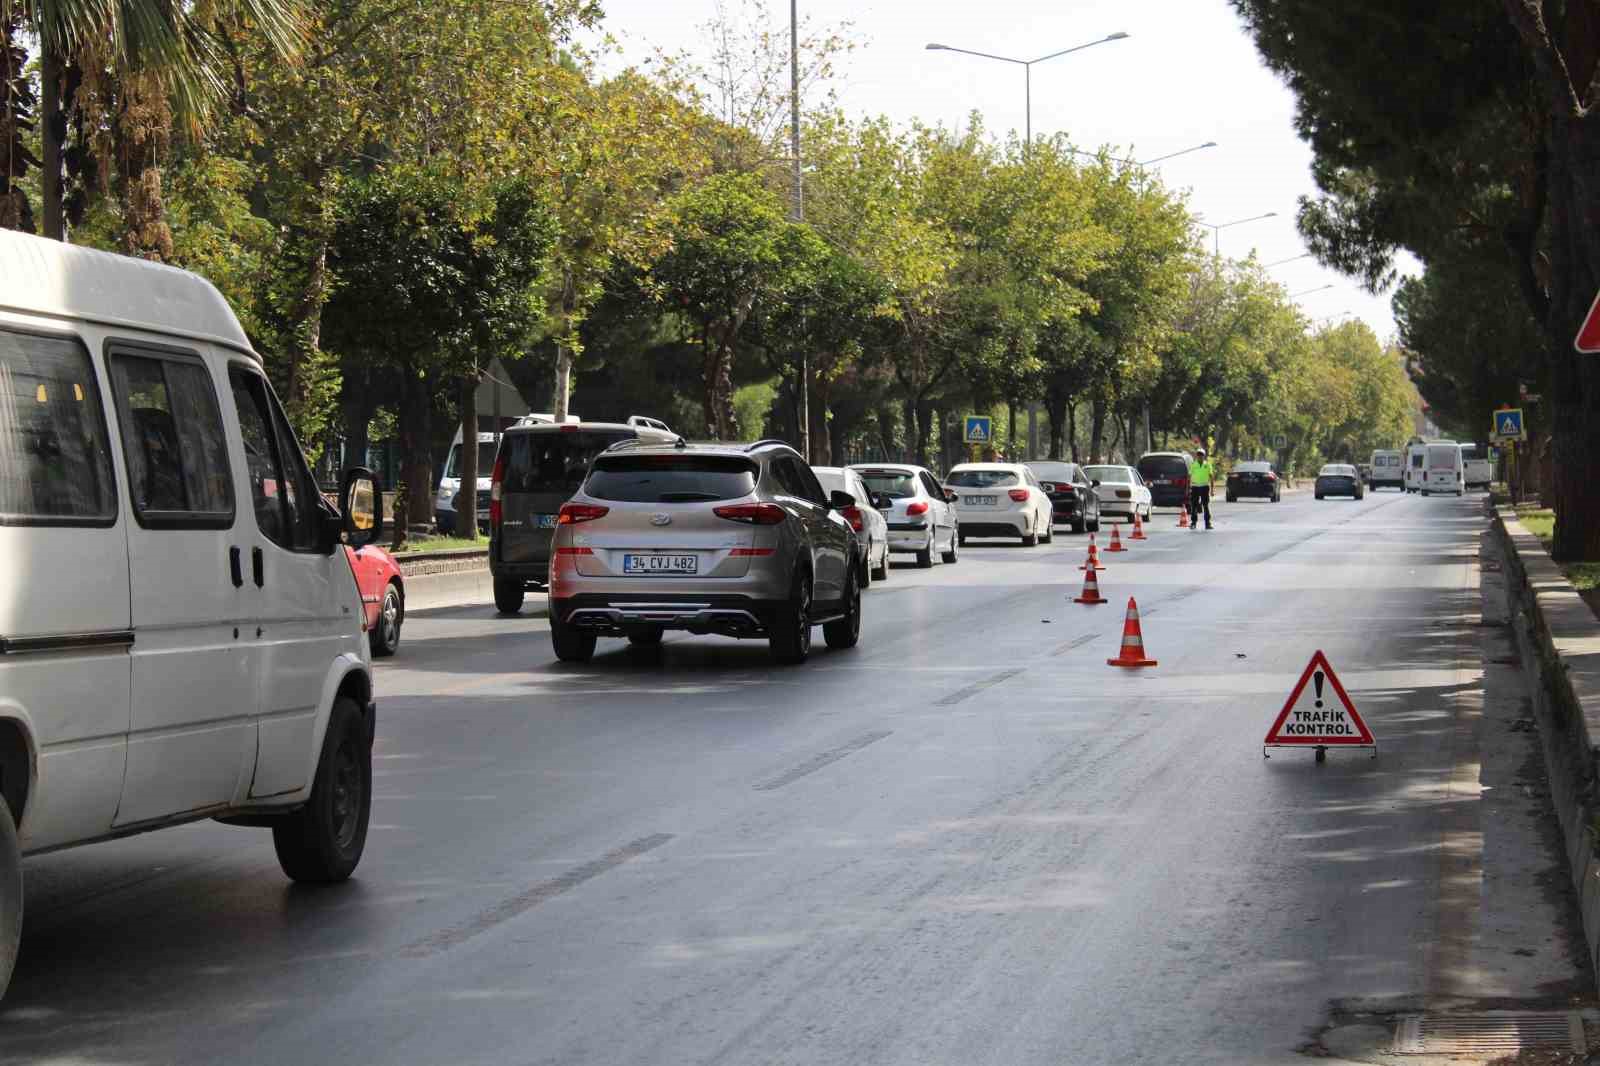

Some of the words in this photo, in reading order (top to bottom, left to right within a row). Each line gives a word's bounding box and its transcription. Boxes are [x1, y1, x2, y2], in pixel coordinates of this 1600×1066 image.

[632, 557, 645, 569] 34
[650, 557, 670, 569] CVJ
[674, 557, 694, 569] 482
[1293, 709, 1345, 722] TRAFİK
[1286, 723, 1353, 735] KONTROL
